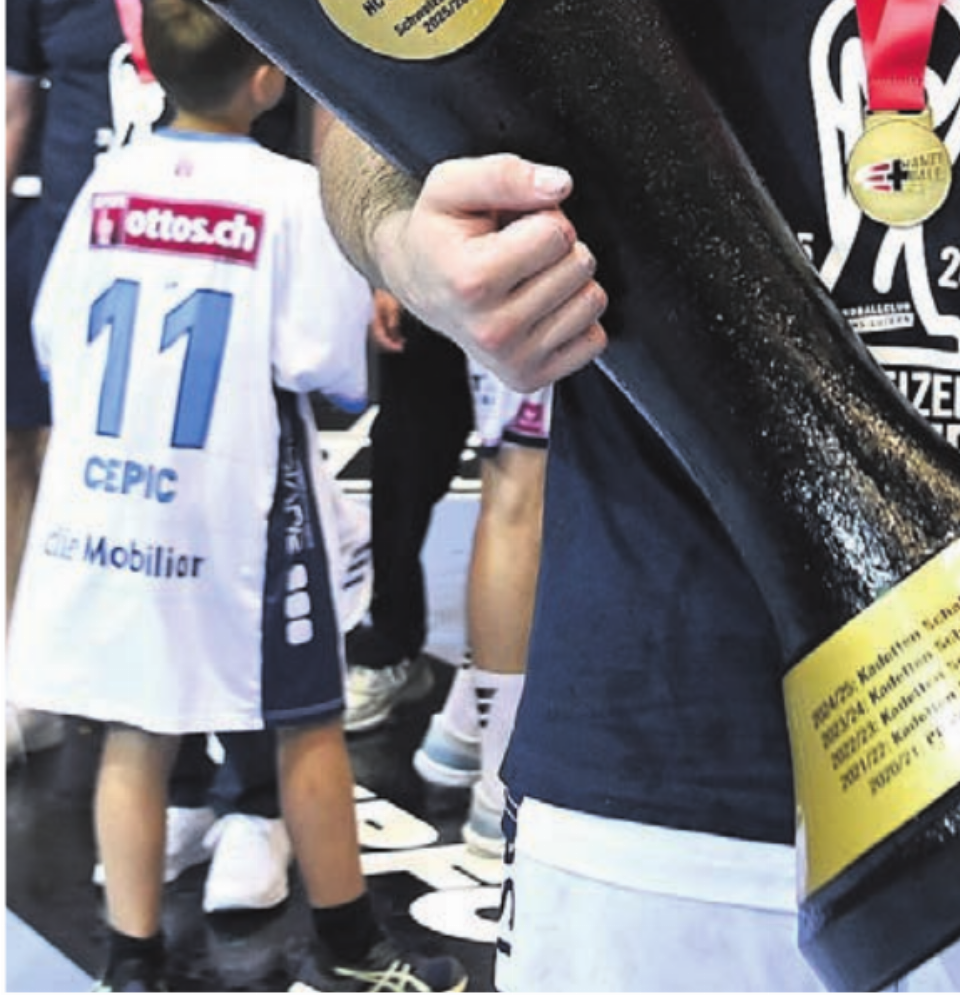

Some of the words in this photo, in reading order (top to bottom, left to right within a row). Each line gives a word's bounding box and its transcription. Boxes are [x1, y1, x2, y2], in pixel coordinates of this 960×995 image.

[125, 208, 256, 252] ottos.ch
[87, 277, 234, 449] 11
[84, 456, 178, 504] CEPIC
